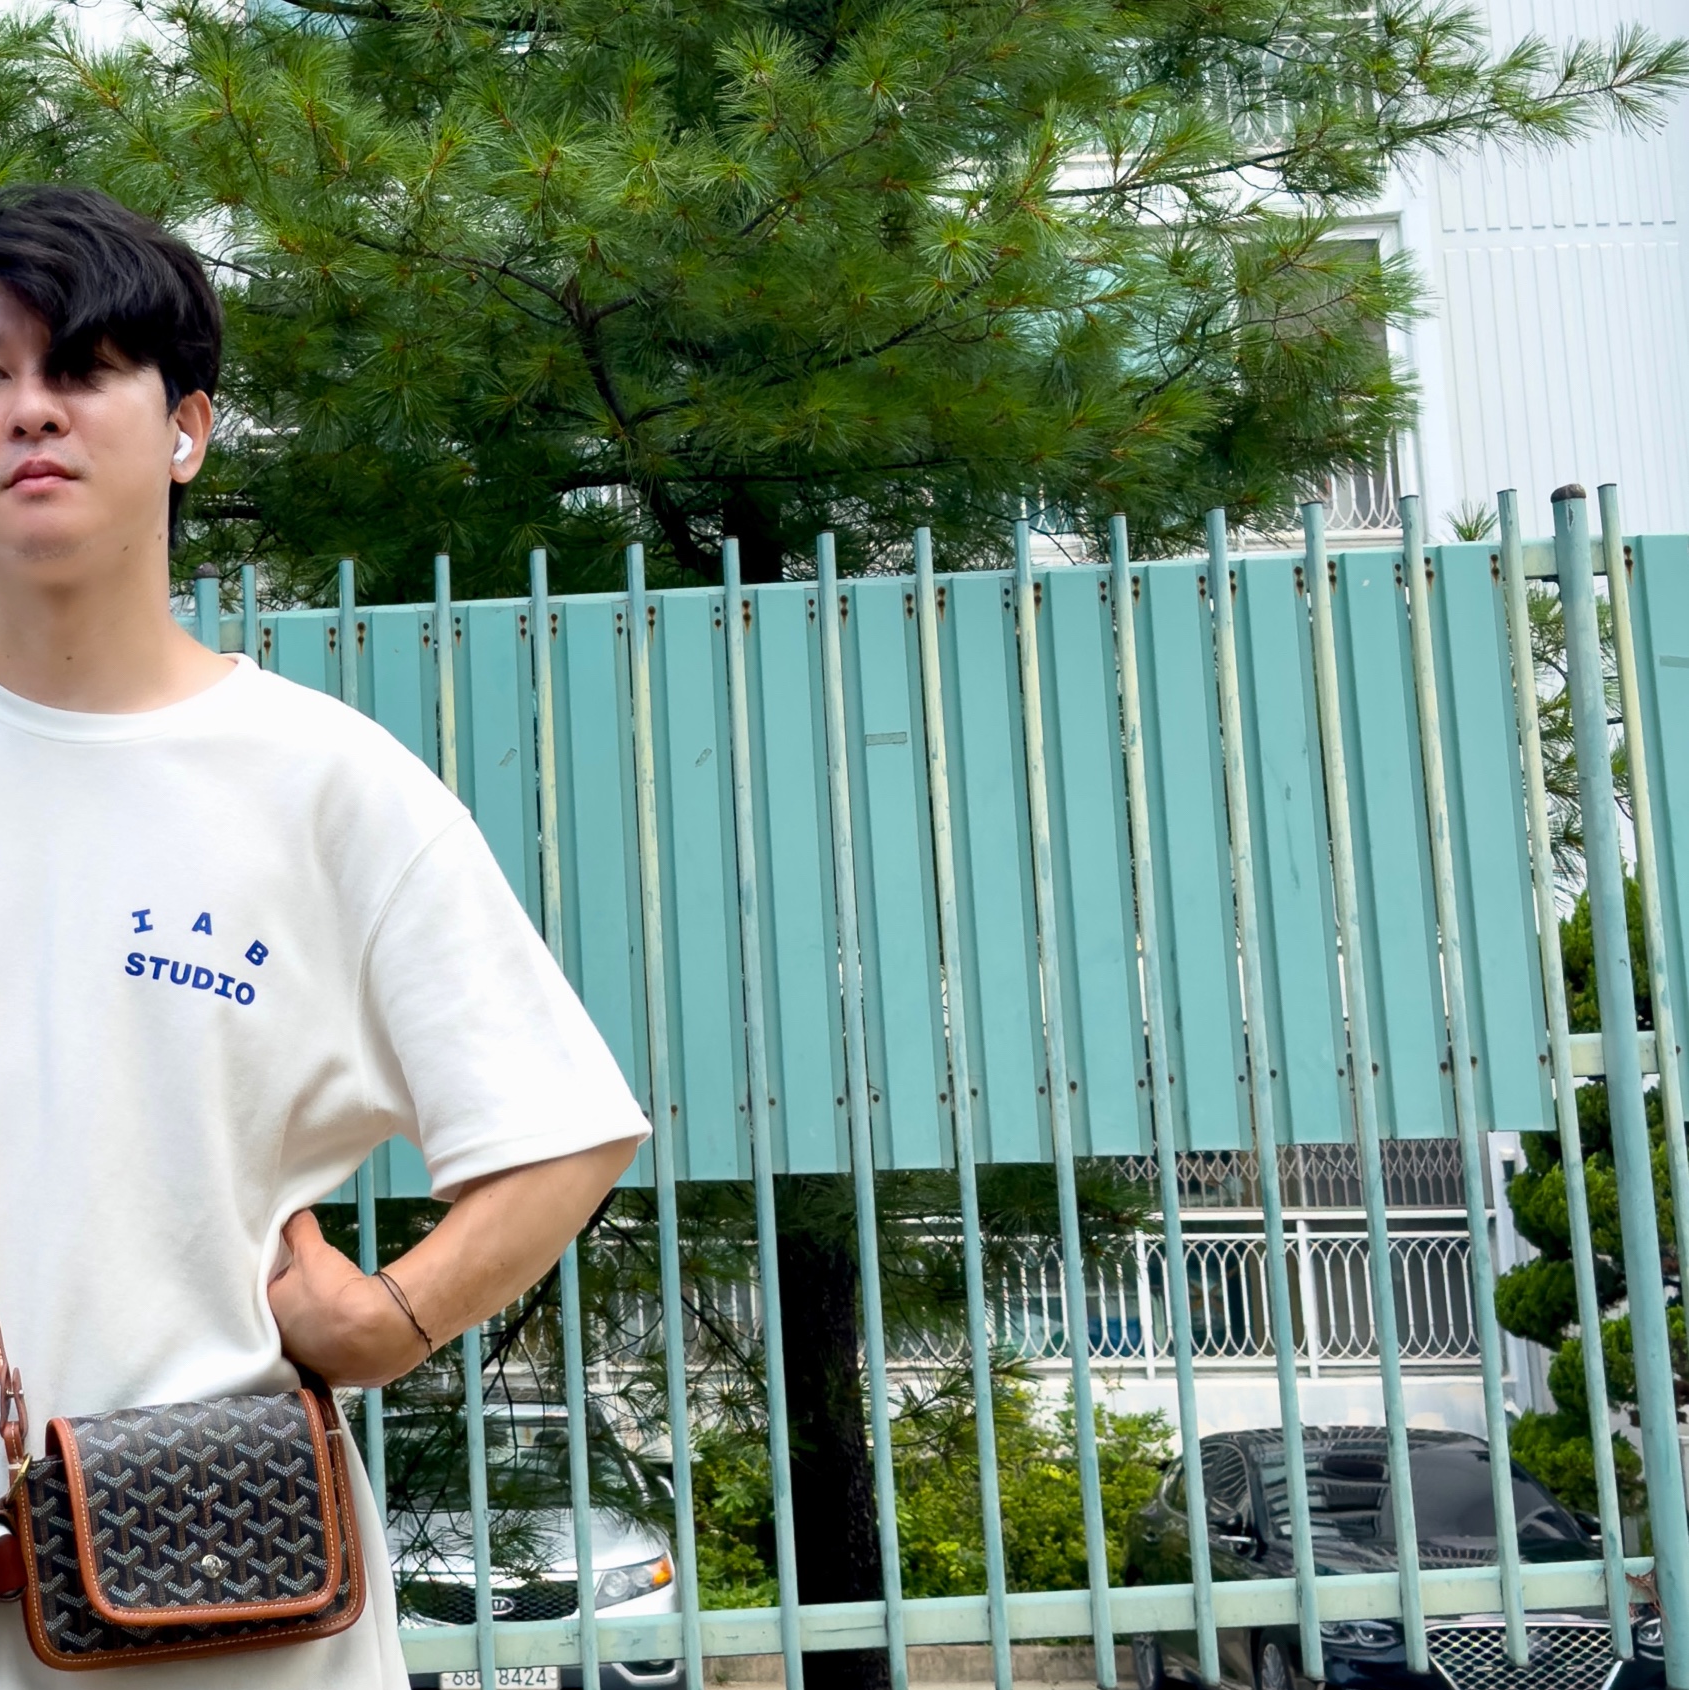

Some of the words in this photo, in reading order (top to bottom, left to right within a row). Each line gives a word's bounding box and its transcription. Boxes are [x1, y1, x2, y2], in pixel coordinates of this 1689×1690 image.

[124, 951, 256, 1006] STUDIO
[452, 1669, 482, 1686] 68
[498, 1667, 547, 1686] 8424
